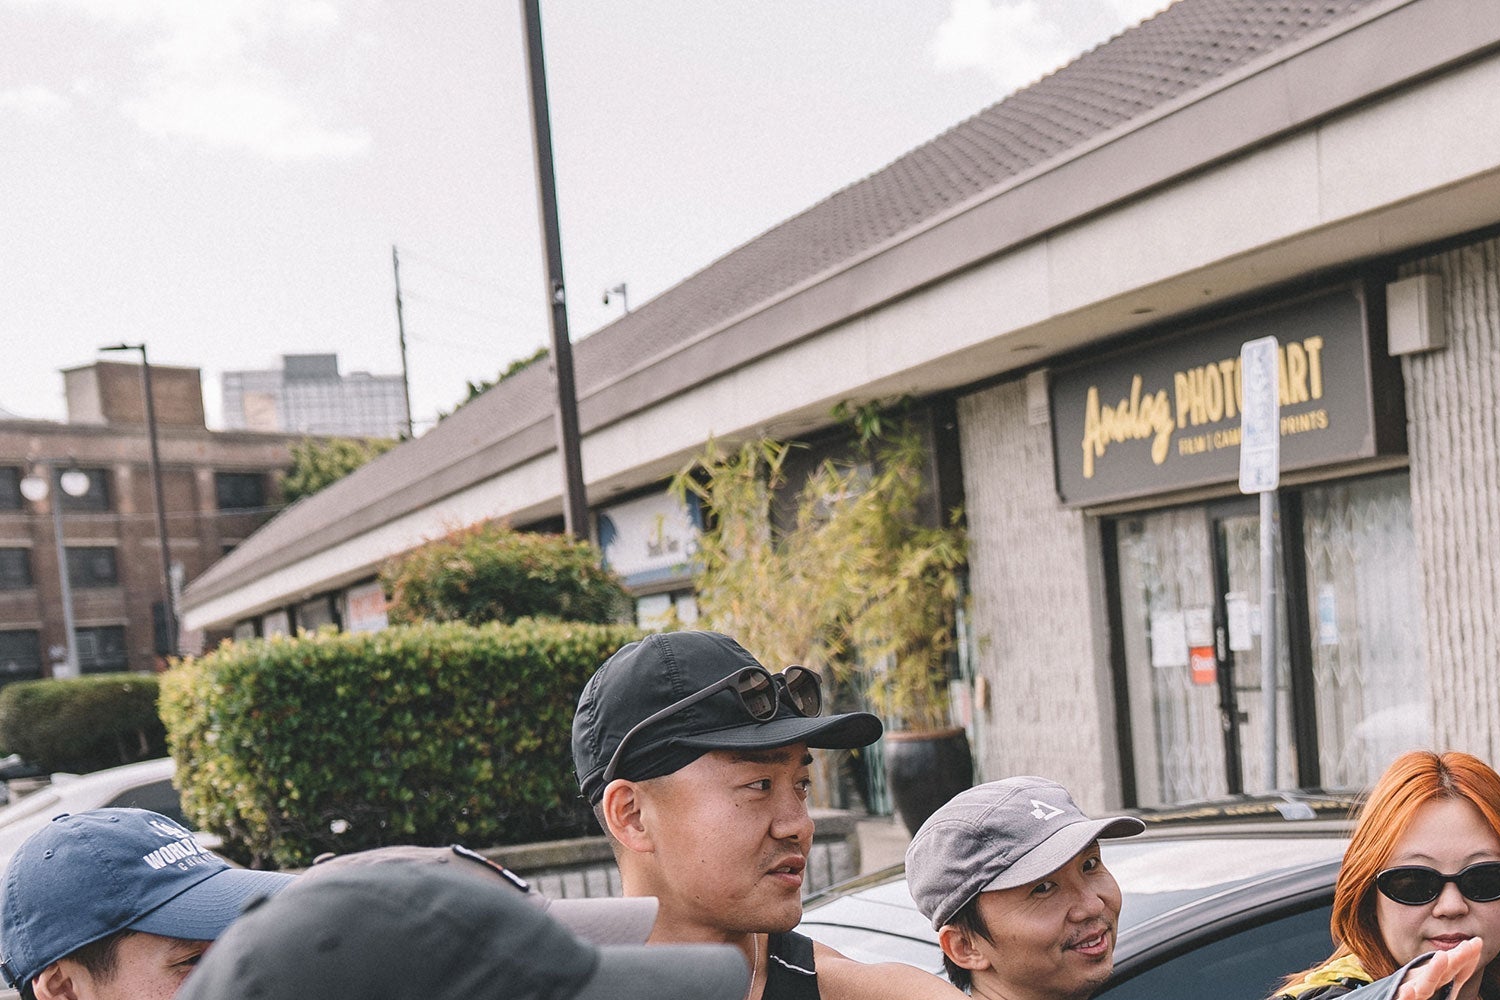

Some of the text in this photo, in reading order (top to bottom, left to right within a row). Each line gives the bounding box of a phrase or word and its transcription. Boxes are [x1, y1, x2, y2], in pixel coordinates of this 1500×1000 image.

[1081, 373, 1175, 479] Analog
[1277, 335, 1324, 407] ART
[1280, 408, 1329, 436] PRINTS
